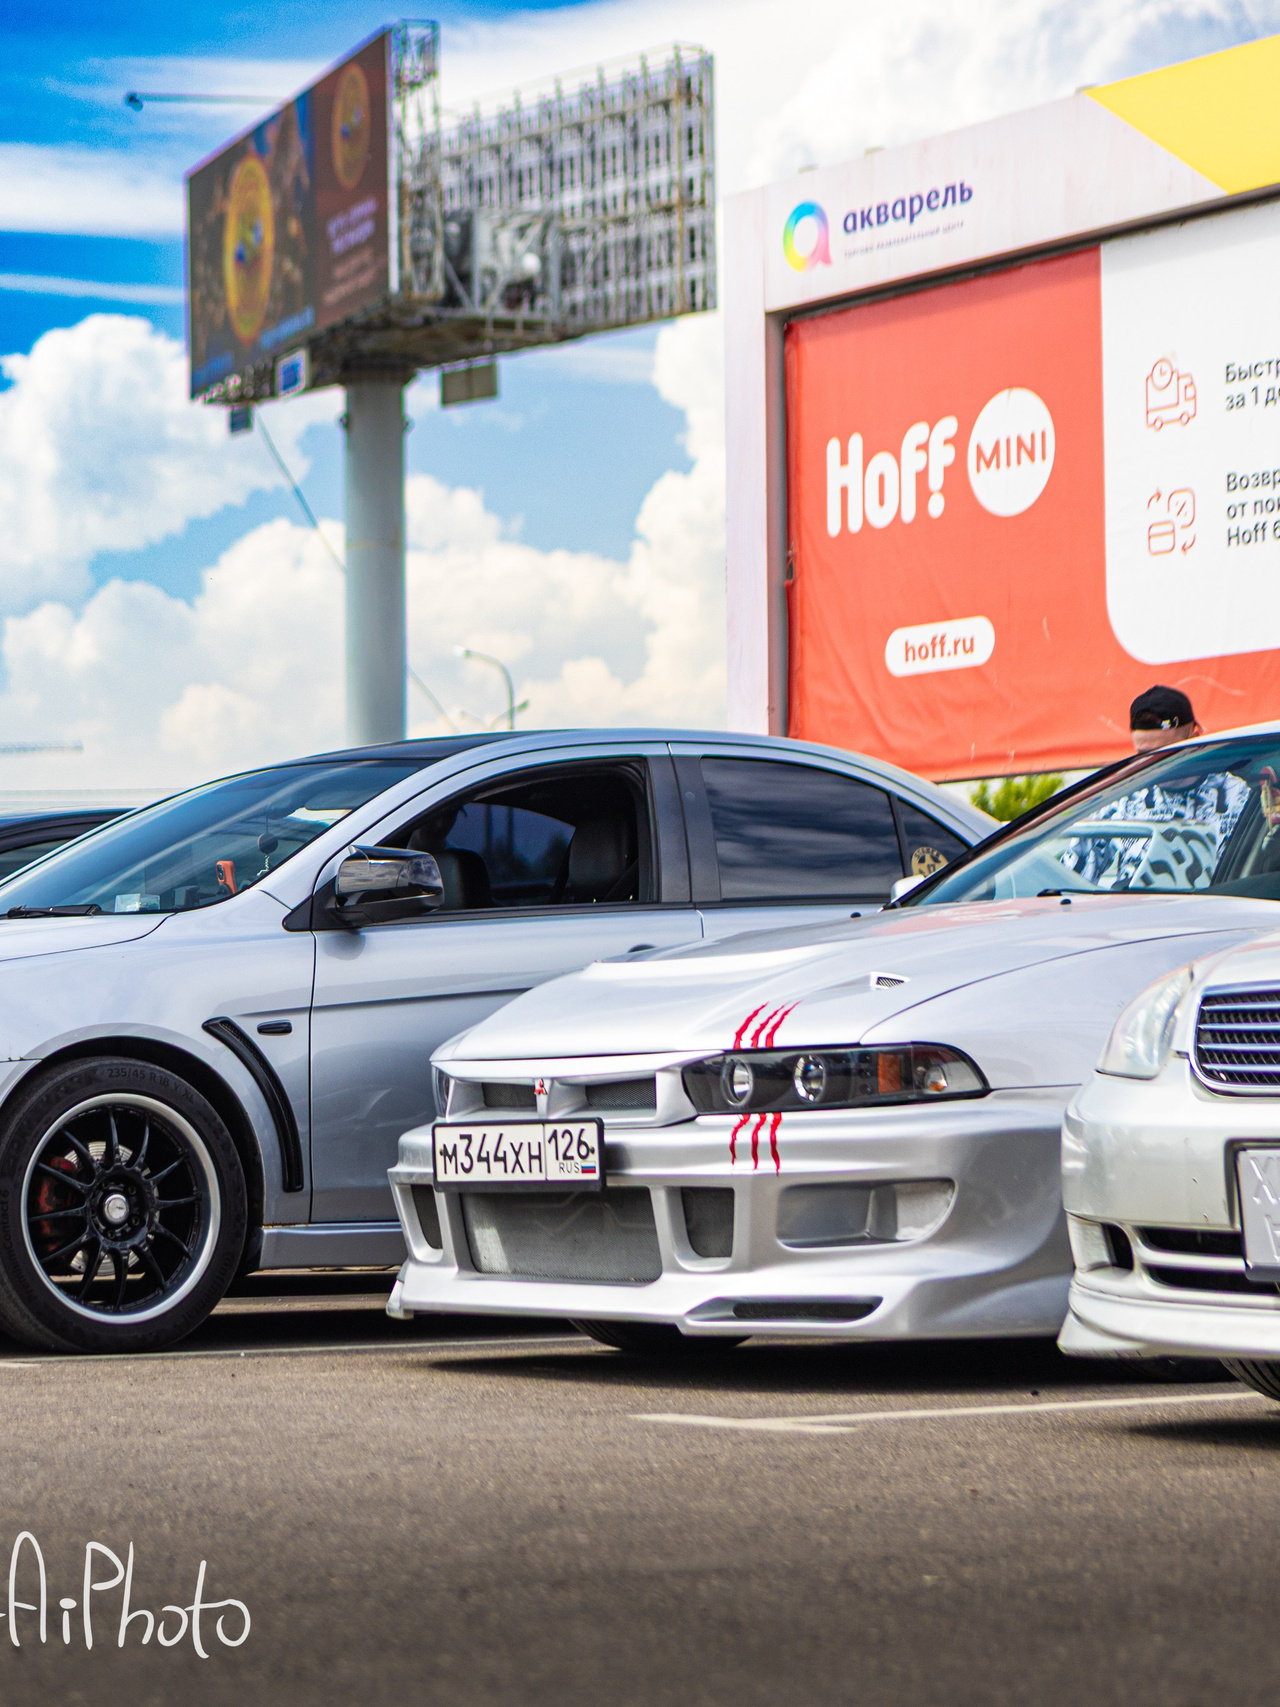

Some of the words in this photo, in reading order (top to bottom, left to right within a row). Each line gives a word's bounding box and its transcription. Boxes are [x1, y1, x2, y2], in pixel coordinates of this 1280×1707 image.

[843, 180, 973, 233] акварель
[1225, 392, 1246, 411] за
[1251, 385, 1259, 406] 1
[976, 429, 1046, 474] MINI
[1227, 502, 1248, 520] от
[1227, 521, 1268, 547] Hoff
[904, 633, 974, 663] hoff.ru
[442, 1133, 543, 1174] М344ХН
[548, 1129, 590, 1161] 126
[558, 1162, 580, 1174] RUS
